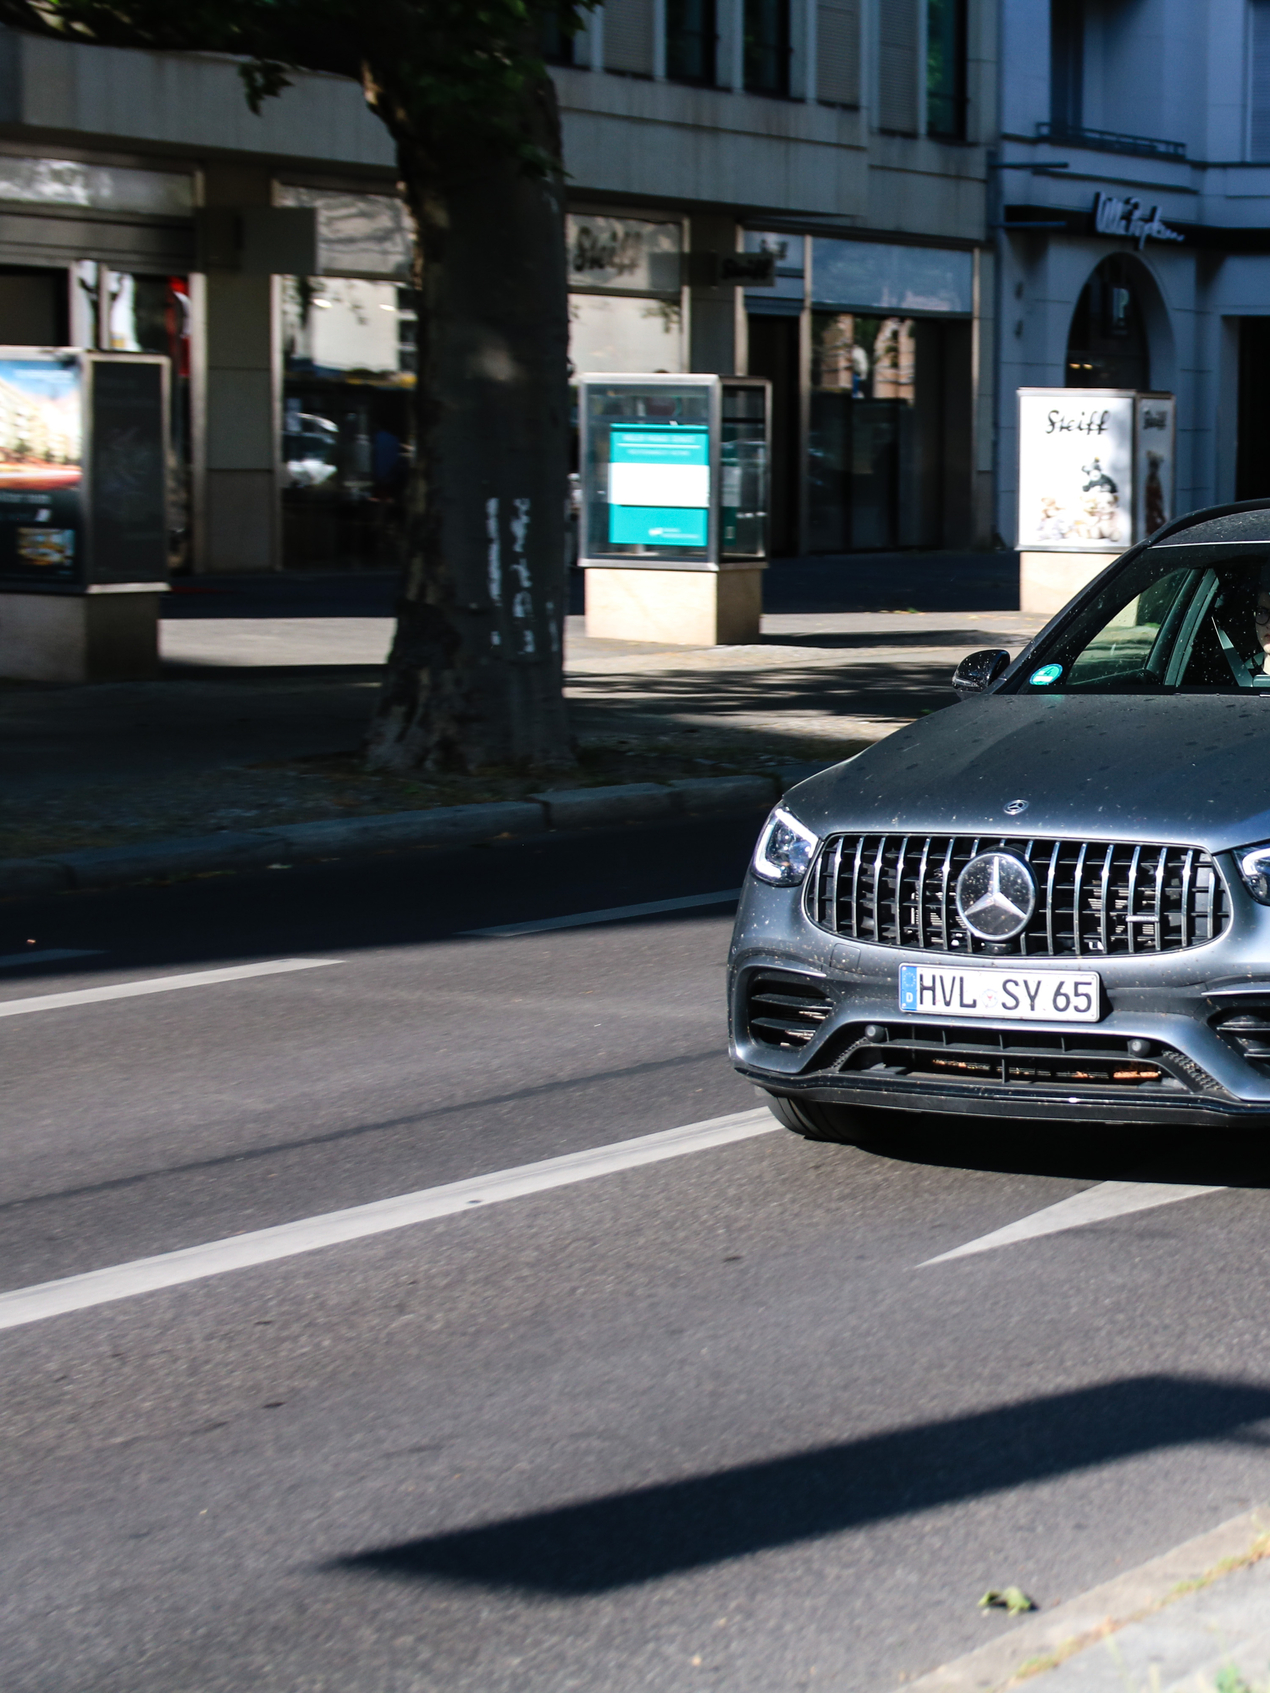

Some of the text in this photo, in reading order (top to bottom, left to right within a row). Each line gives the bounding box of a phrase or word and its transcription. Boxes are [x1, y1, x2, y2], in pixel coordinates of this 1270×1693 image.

[1045, 409, 1110, 436] Steiff
[919, 973, 1093, 1013] HVL SY 65
